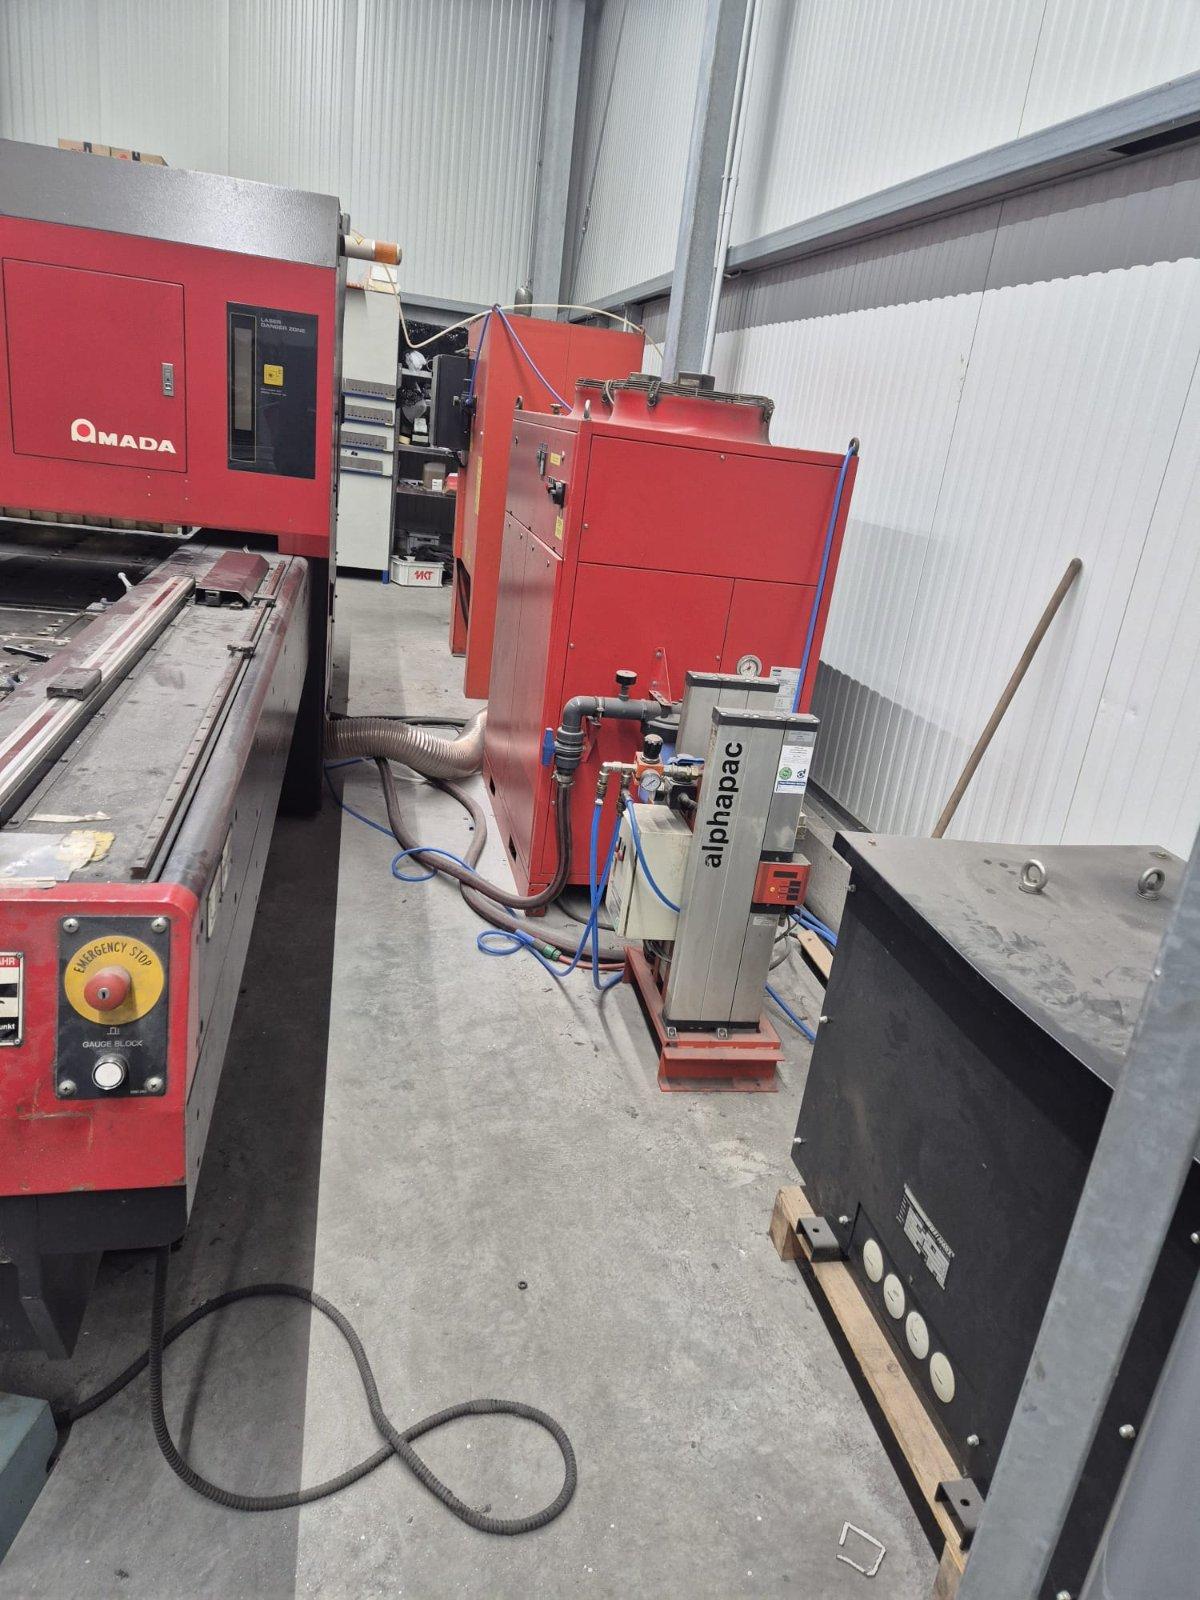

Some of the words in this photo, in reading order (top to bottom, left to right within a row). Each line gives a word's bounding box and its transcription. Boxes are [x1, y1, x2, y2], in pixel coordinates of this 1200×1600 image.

[260, 317, 282, 325] LASER
[260, 322, 287, 331] DANGER
[288, 326, 306, 334] ZONE
[71, 418, 177, 454] AMADA
[702, 742, 743, 869] alphapac
[74, 941, 128, 974] EMERGENCY
[129, 946, 152, 967] STOP
[82, 1040, 112, 1048] GAUGE
[114, 1040, 144, 1048] BLOCK
